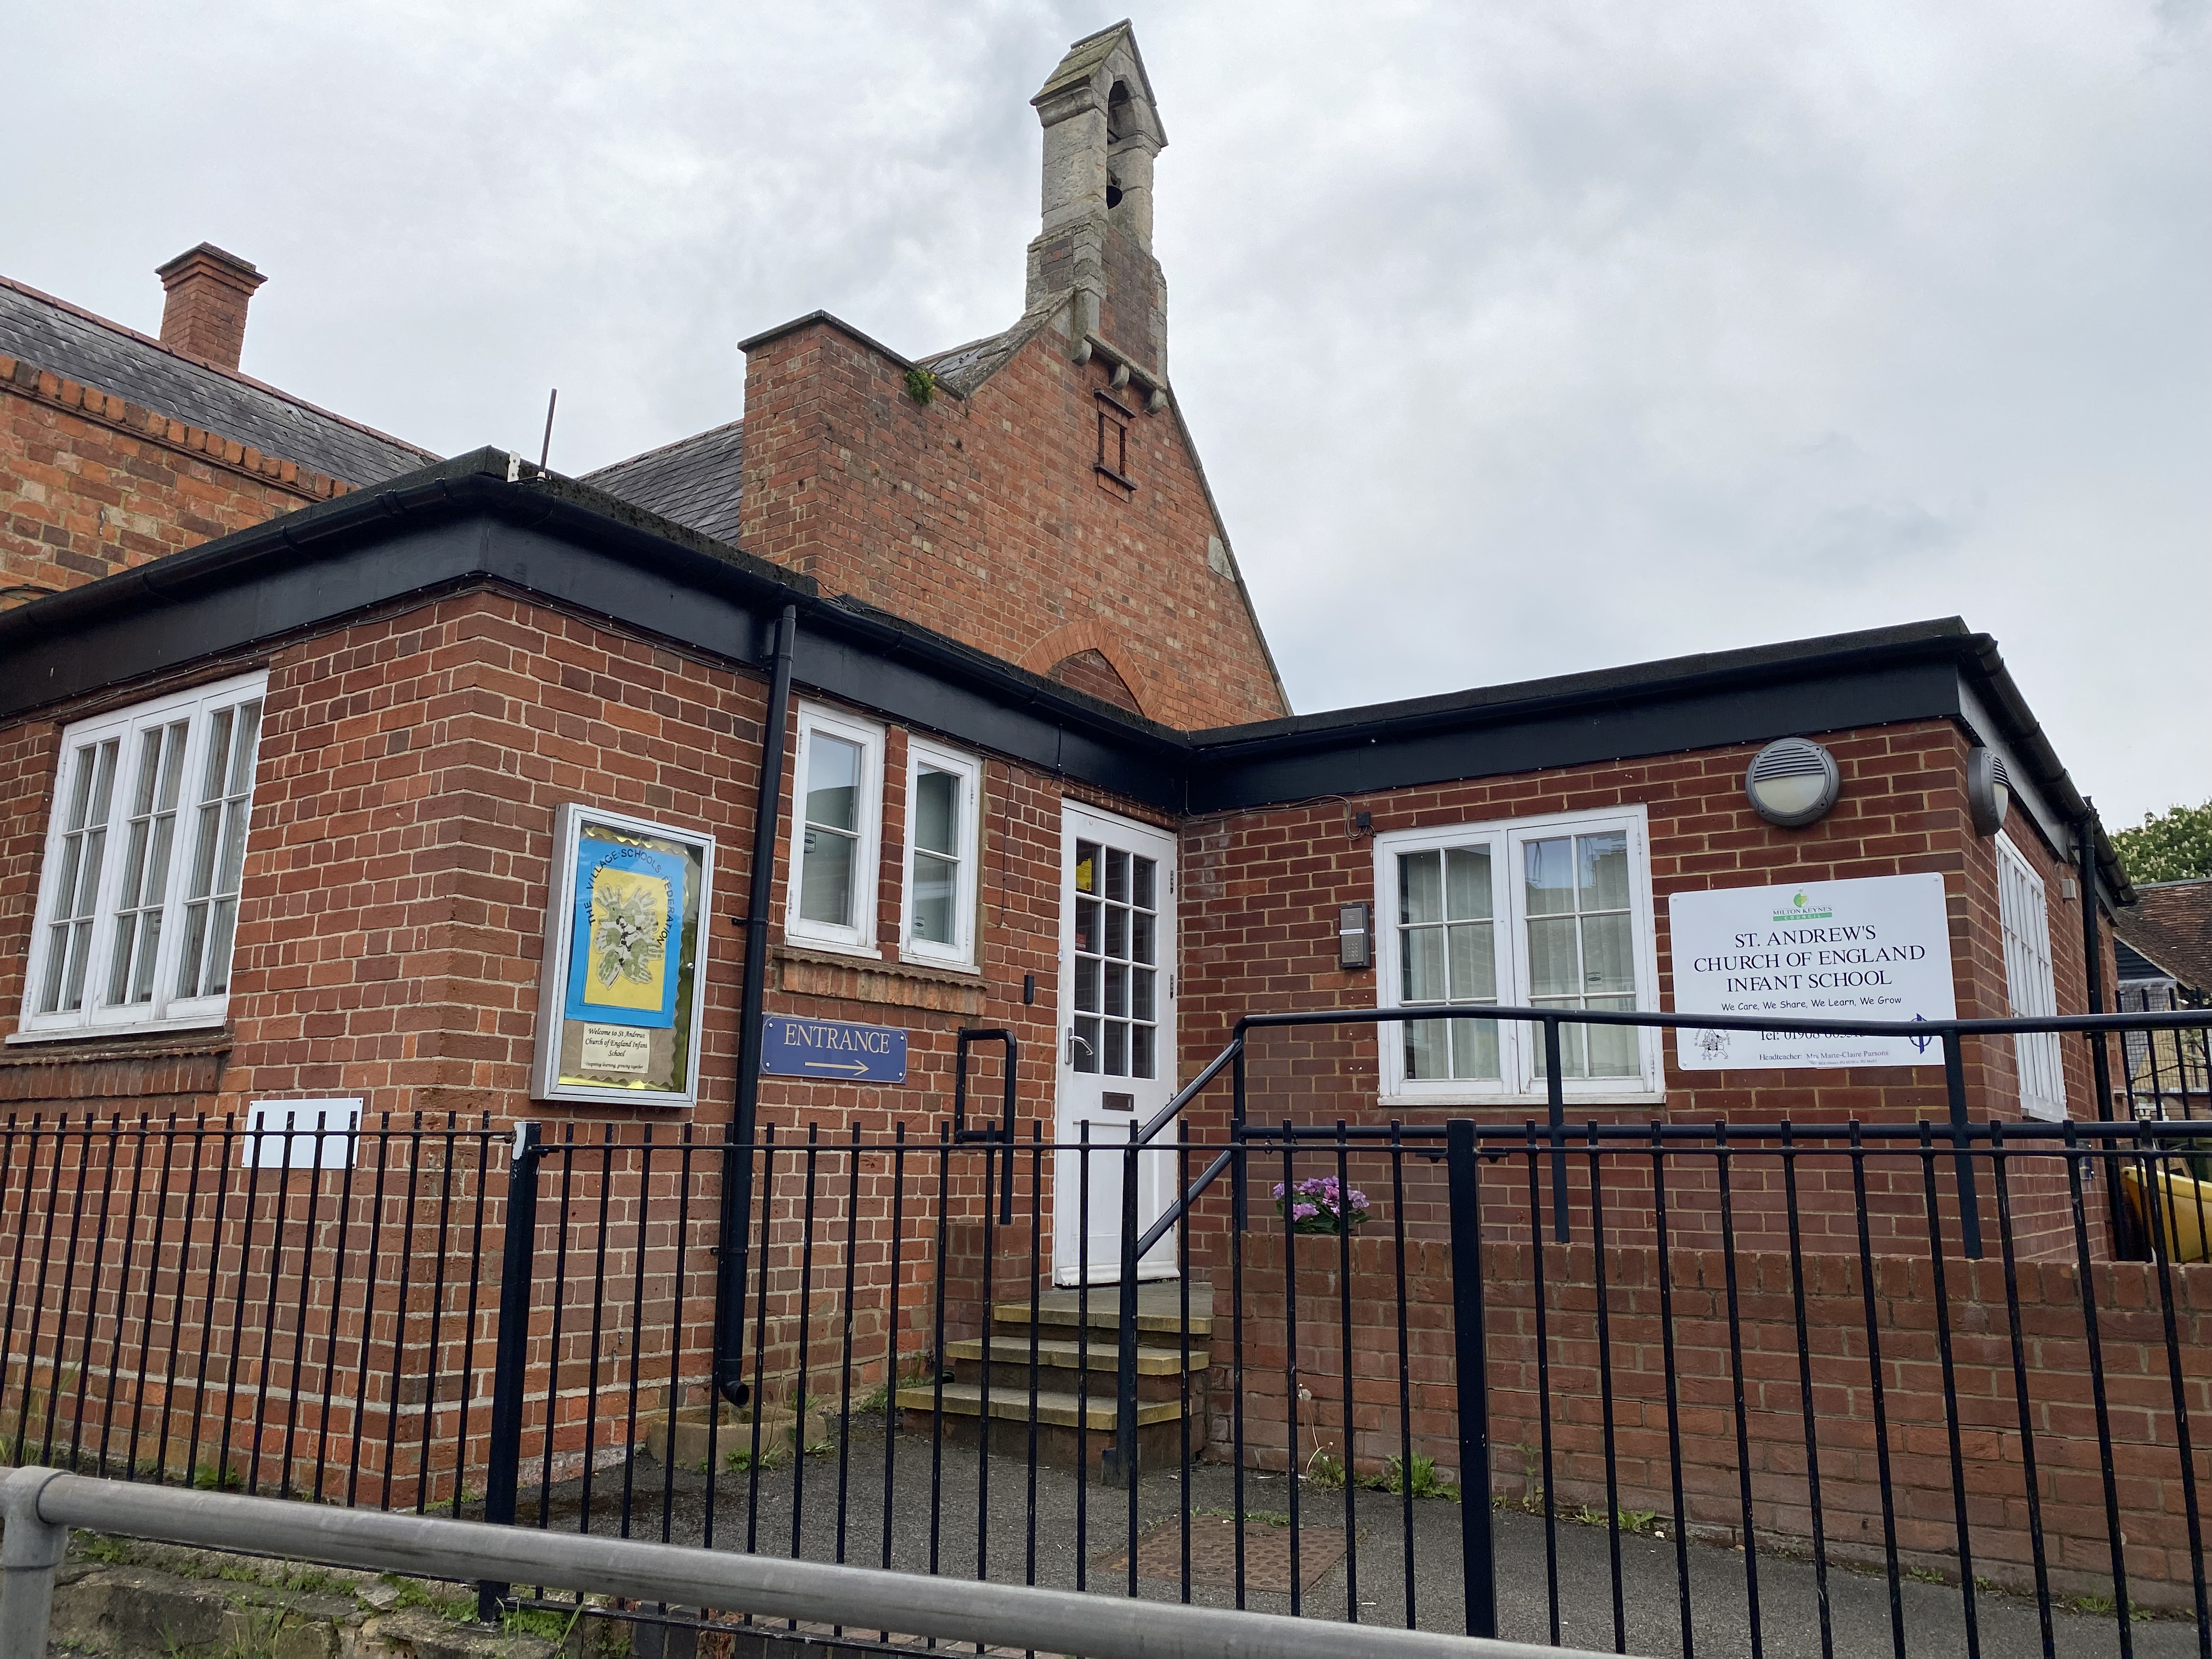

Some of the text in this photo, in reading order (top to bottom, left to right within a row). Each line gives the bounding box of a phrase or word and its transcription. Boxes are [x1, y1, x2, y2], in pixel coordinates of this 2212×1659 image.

[584, 848, 675, 946] THE VILLAGE SCHOOLS FEDERATION
[1735, 924, 1877, 948] ST. ANDREW'S
[1694, 945, 1926, 972] CHURCH OF ENGLAND
[1726, 970, 1893, 992] INFANT SCHOOL
[1721, 996, 1901, 1011] We Care, We Share, We Learn, We Grow
[588, 1028, 611, 1036] Welcome
[783, 1023, 890, 1054] ENTRANCE
[604, 1039, 611, 1047] of
[611, 1040, 633, 1048] England
[633, 1041, 648, 1049] Infant
[608, 1049, 627, 1057] School
